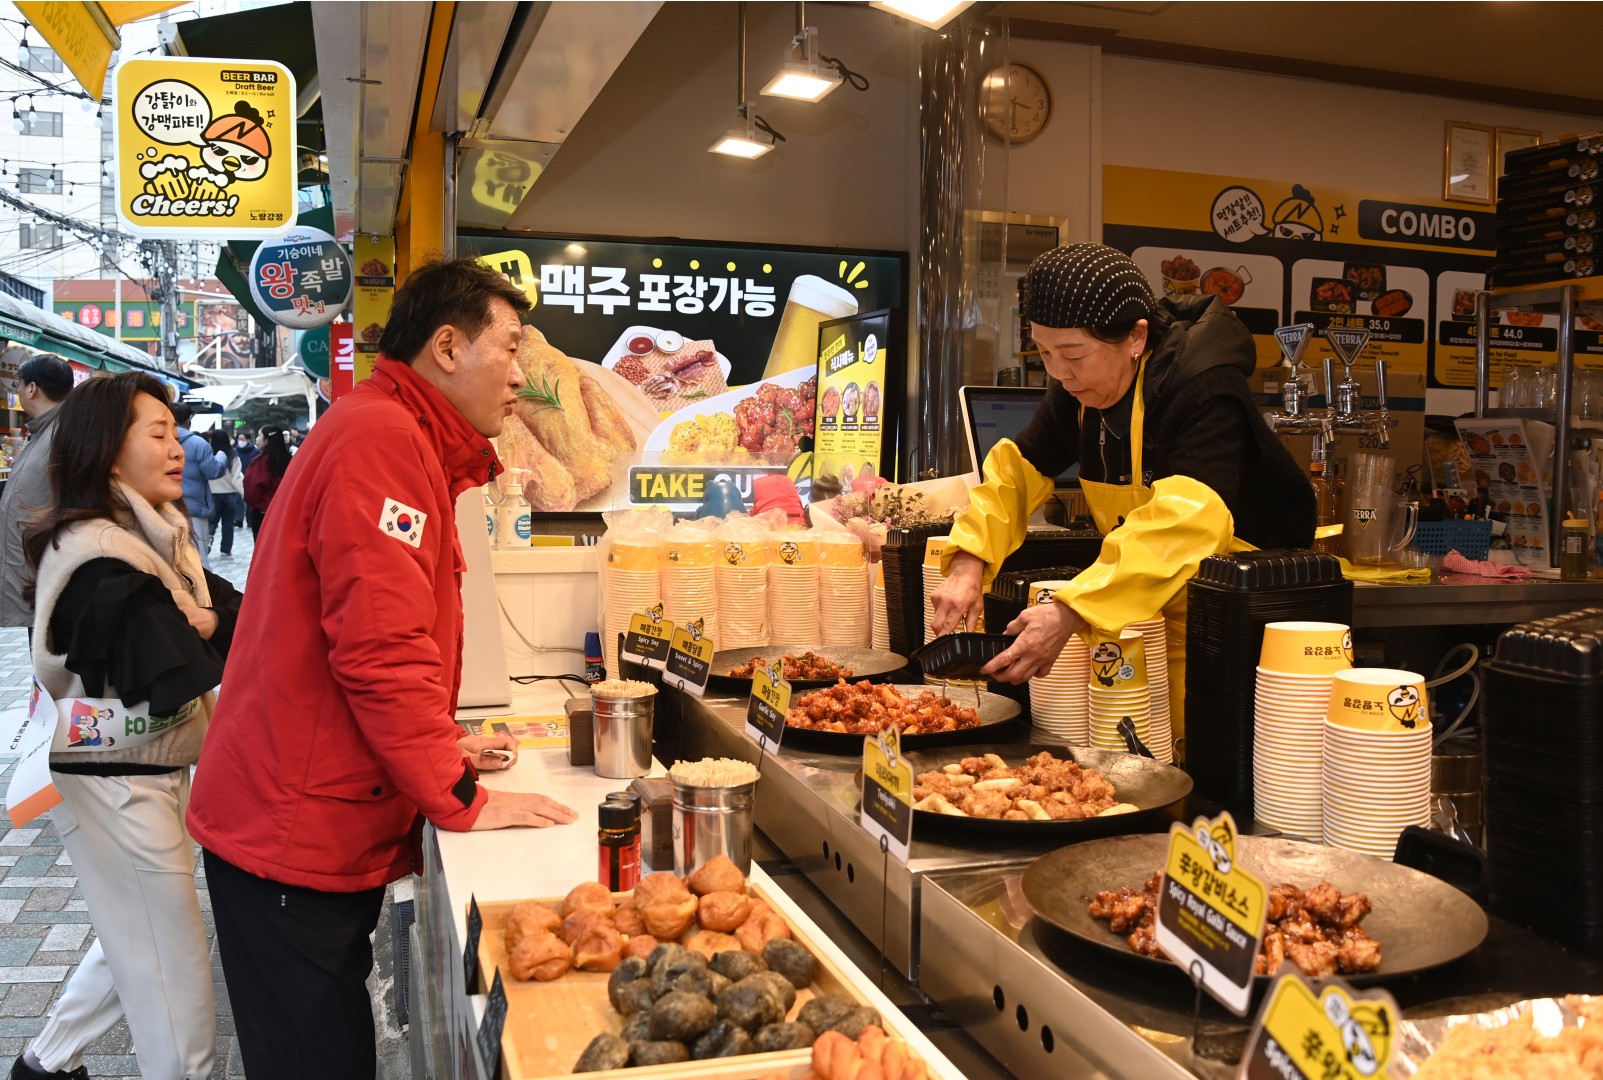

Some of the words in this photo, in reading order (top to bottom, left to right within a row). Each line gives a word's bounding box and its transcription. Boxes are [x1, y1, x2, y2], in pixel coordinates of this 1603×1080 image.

[222, 72, 250, 81] BEER
[253, 73, 276, 83] BAR
[235, 83, 255, 91] Draft
[142, 114, 204, 131] 강맥파티!
[131, 194, 240, 217] Cheers!
[1216, 193, 1253, 221] 먹잘알!!
[250, 213, 283, 221] 노랑강정
[1223, 206, 1262, 238] 세트추천!
[1381, 208, 1476, 241] COMBO
[278, 245, 323, 260] 기승이네
[541, 264, 631, 316] 맥주
[638, 273, 777, 318] 포장가능
[291, 295, 325, 317] 맛집
[1329, 317, 1344, 328] 2인
[1346, 318, 1364, 328] 세트
[1369, 320, 1390, 330] 35.0
[1281, 332, 1302, 344] TERRA
[1335, 334, 1363, 346] TERRA
[1503, 328, 1523, 339] 44.0
[307, 340, 330, 353] CA
[636, 473, 704, 498] TAKE
[640, 623, 662, 637] 매콤간장
[638, 635, 650, 645] Spicy
[650, 639, 660, 647] Soy
[682, 640, 703, 658] 매콤달콤
[1304, 646, 1341, 656] 노랑강정
[675, 652, 687, 664] Sweet
[692, 660, 703, 671] Spicy
[762, 685, 780, 707] 마늘간장
[1344, 697, 1384, 711] 노랑강정
[769, 709, 777, 722] Soy
[1179, 852, 1249, 919] 辛왕갈비소스
[1169, 881, 1186, 906] Spicy
[1186, 893, 1207, 919] Royal
[1206, 908, 1227, 934] Galbi
[1225, 922, 1248, 950] Sauce
